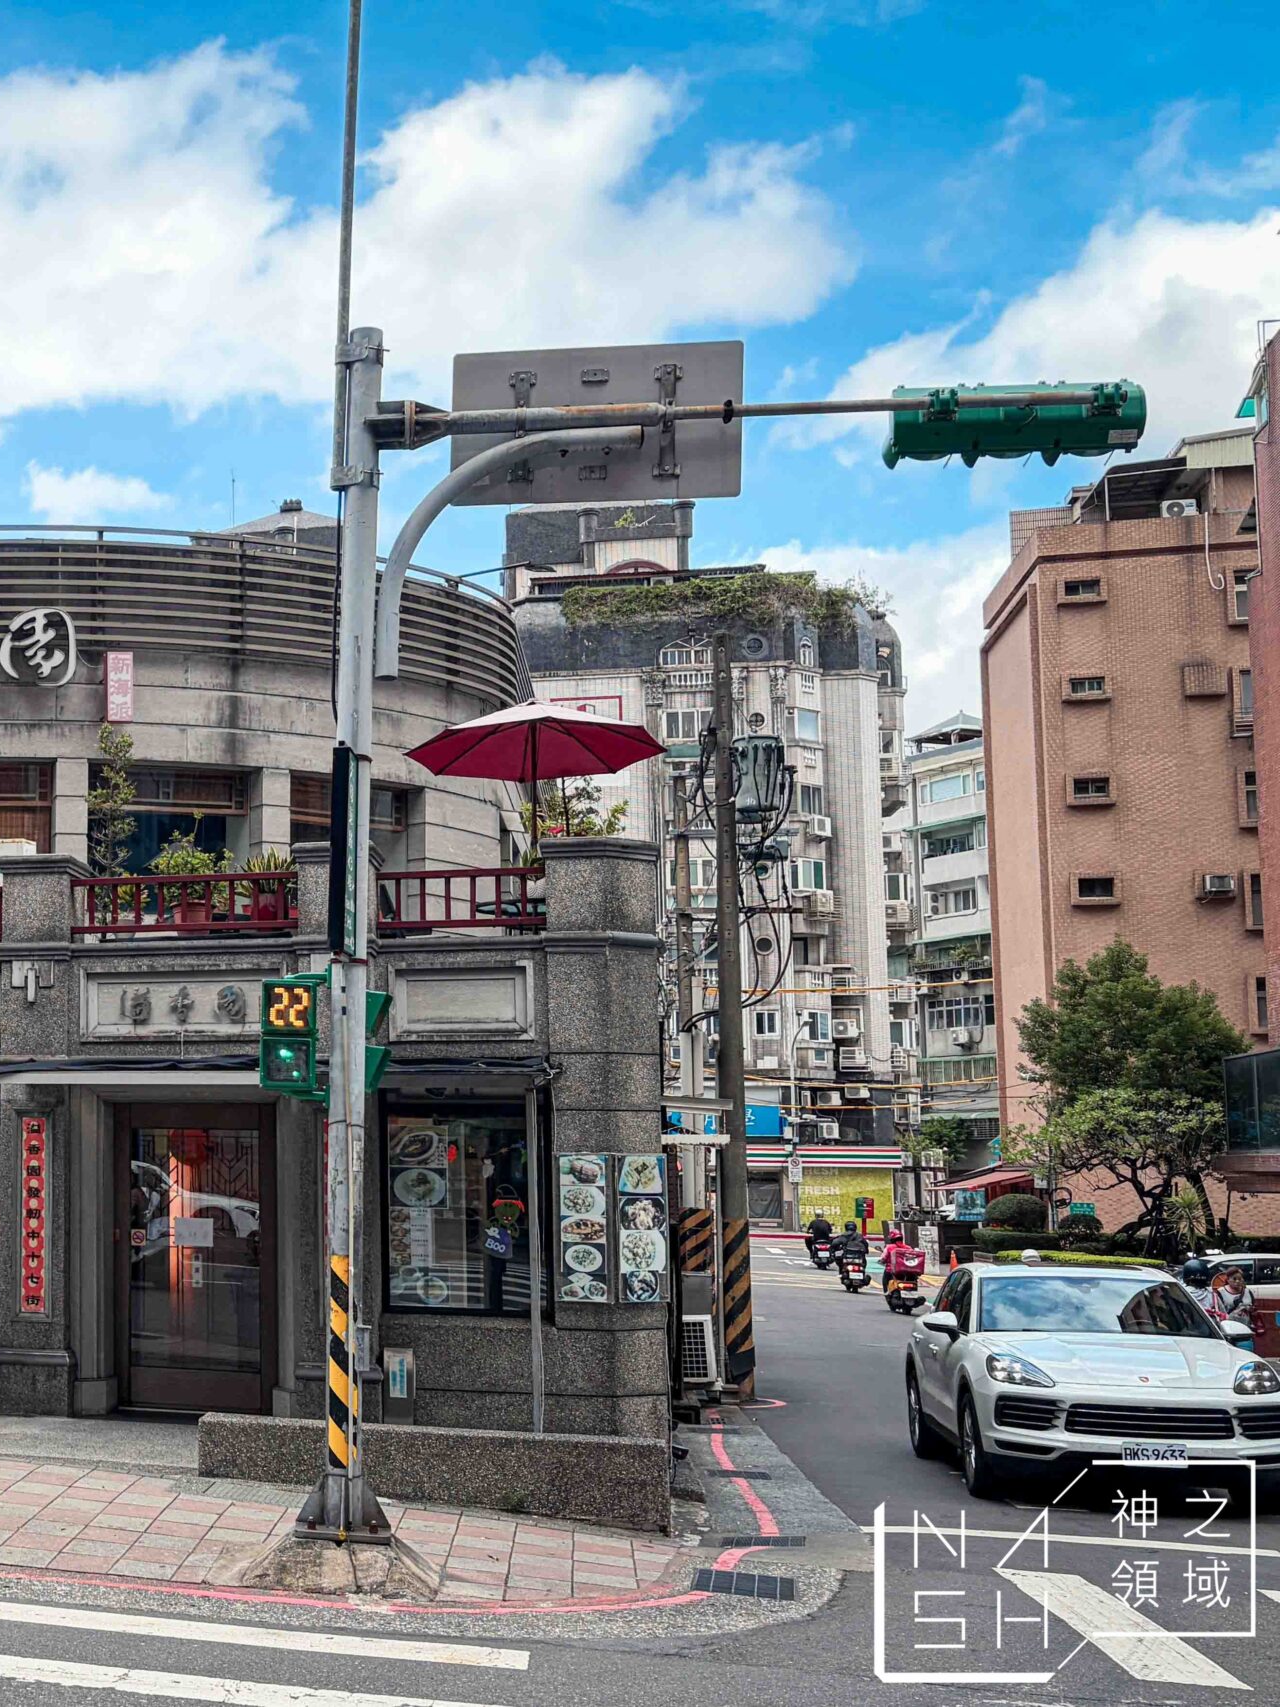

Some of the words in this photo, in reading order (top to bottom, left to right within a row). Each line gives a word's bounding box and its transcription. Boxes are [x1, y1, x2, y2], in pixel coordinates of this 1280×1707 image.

[110, 655, 131, 720] 新海派
[270, 987, 309, 1027] 22
[799, 1185, 840, 1195] FRESH
